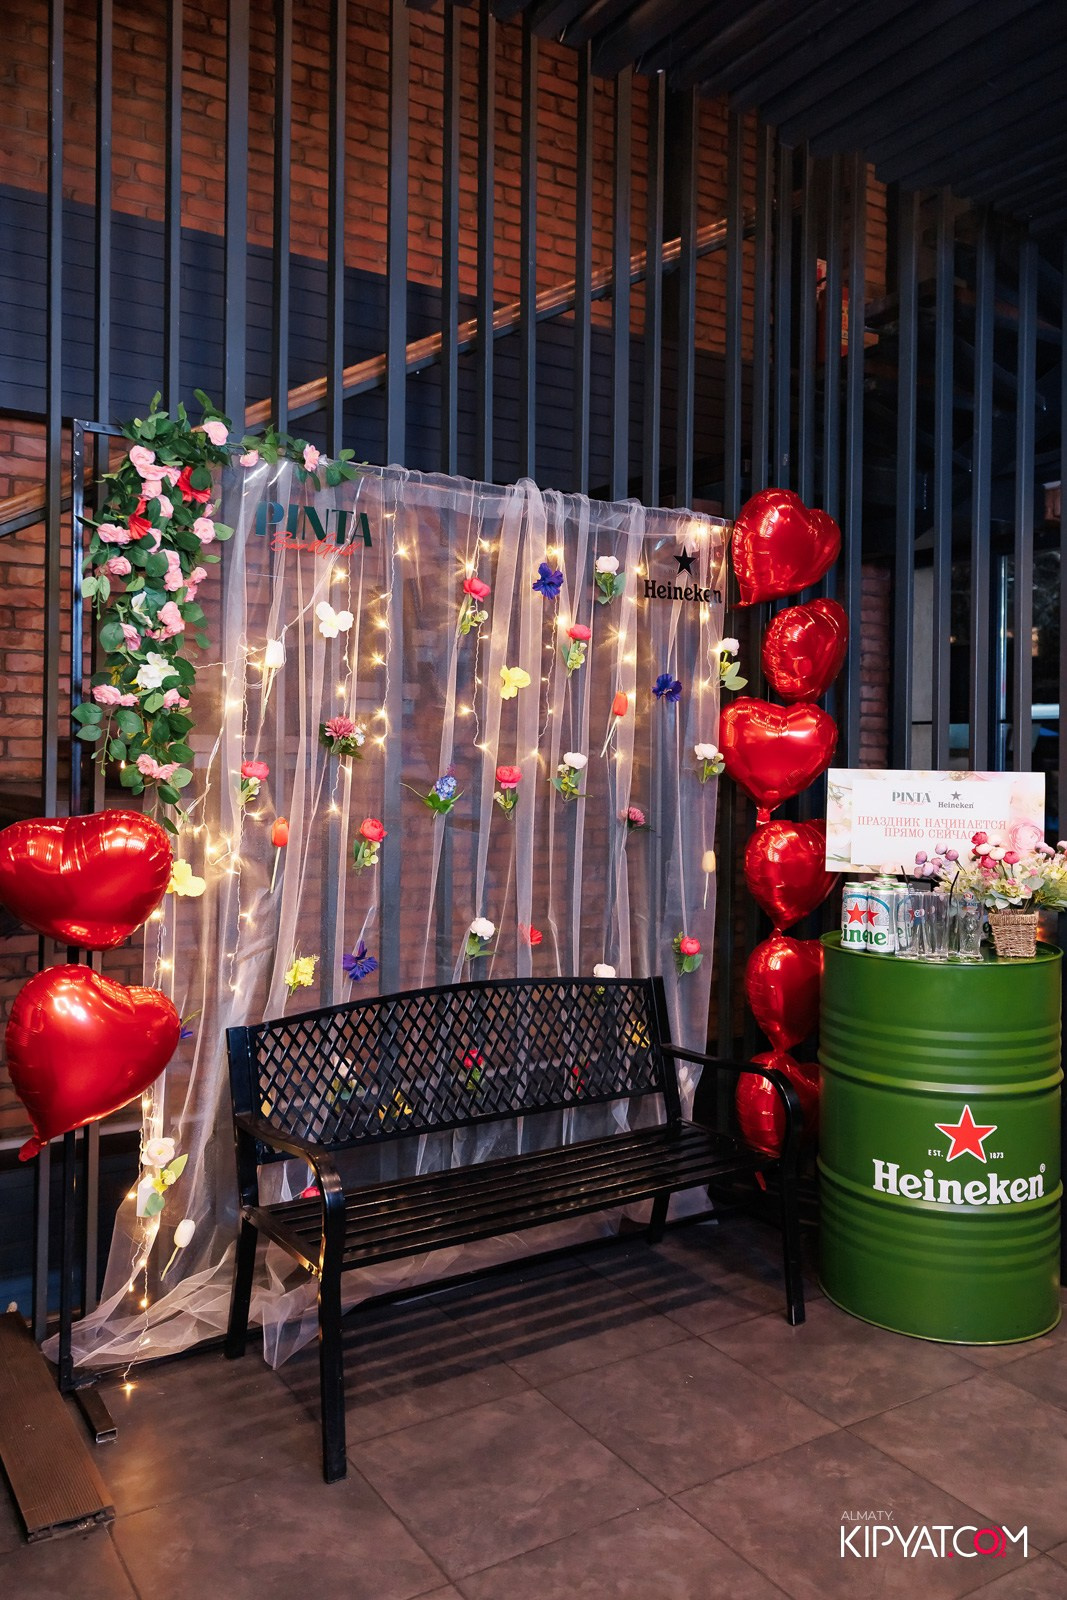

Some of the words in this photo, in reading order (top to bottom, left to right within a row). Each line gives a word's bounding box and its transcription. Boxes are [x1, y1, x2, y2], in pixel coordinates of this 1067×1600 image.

[255, 501, 372, 547] PINTA
[644, 580, 722, 603] Heineken
[892, 791, 931, 803] PINTA
[938, 801, 974, 809] Heineken
[857, 815, 920, 828] ПРАЗДНИК
[925, 818, 1007, 831] НАЧИНАЕТСЯ
[884, 827, 925, 839] ПРЯМО
